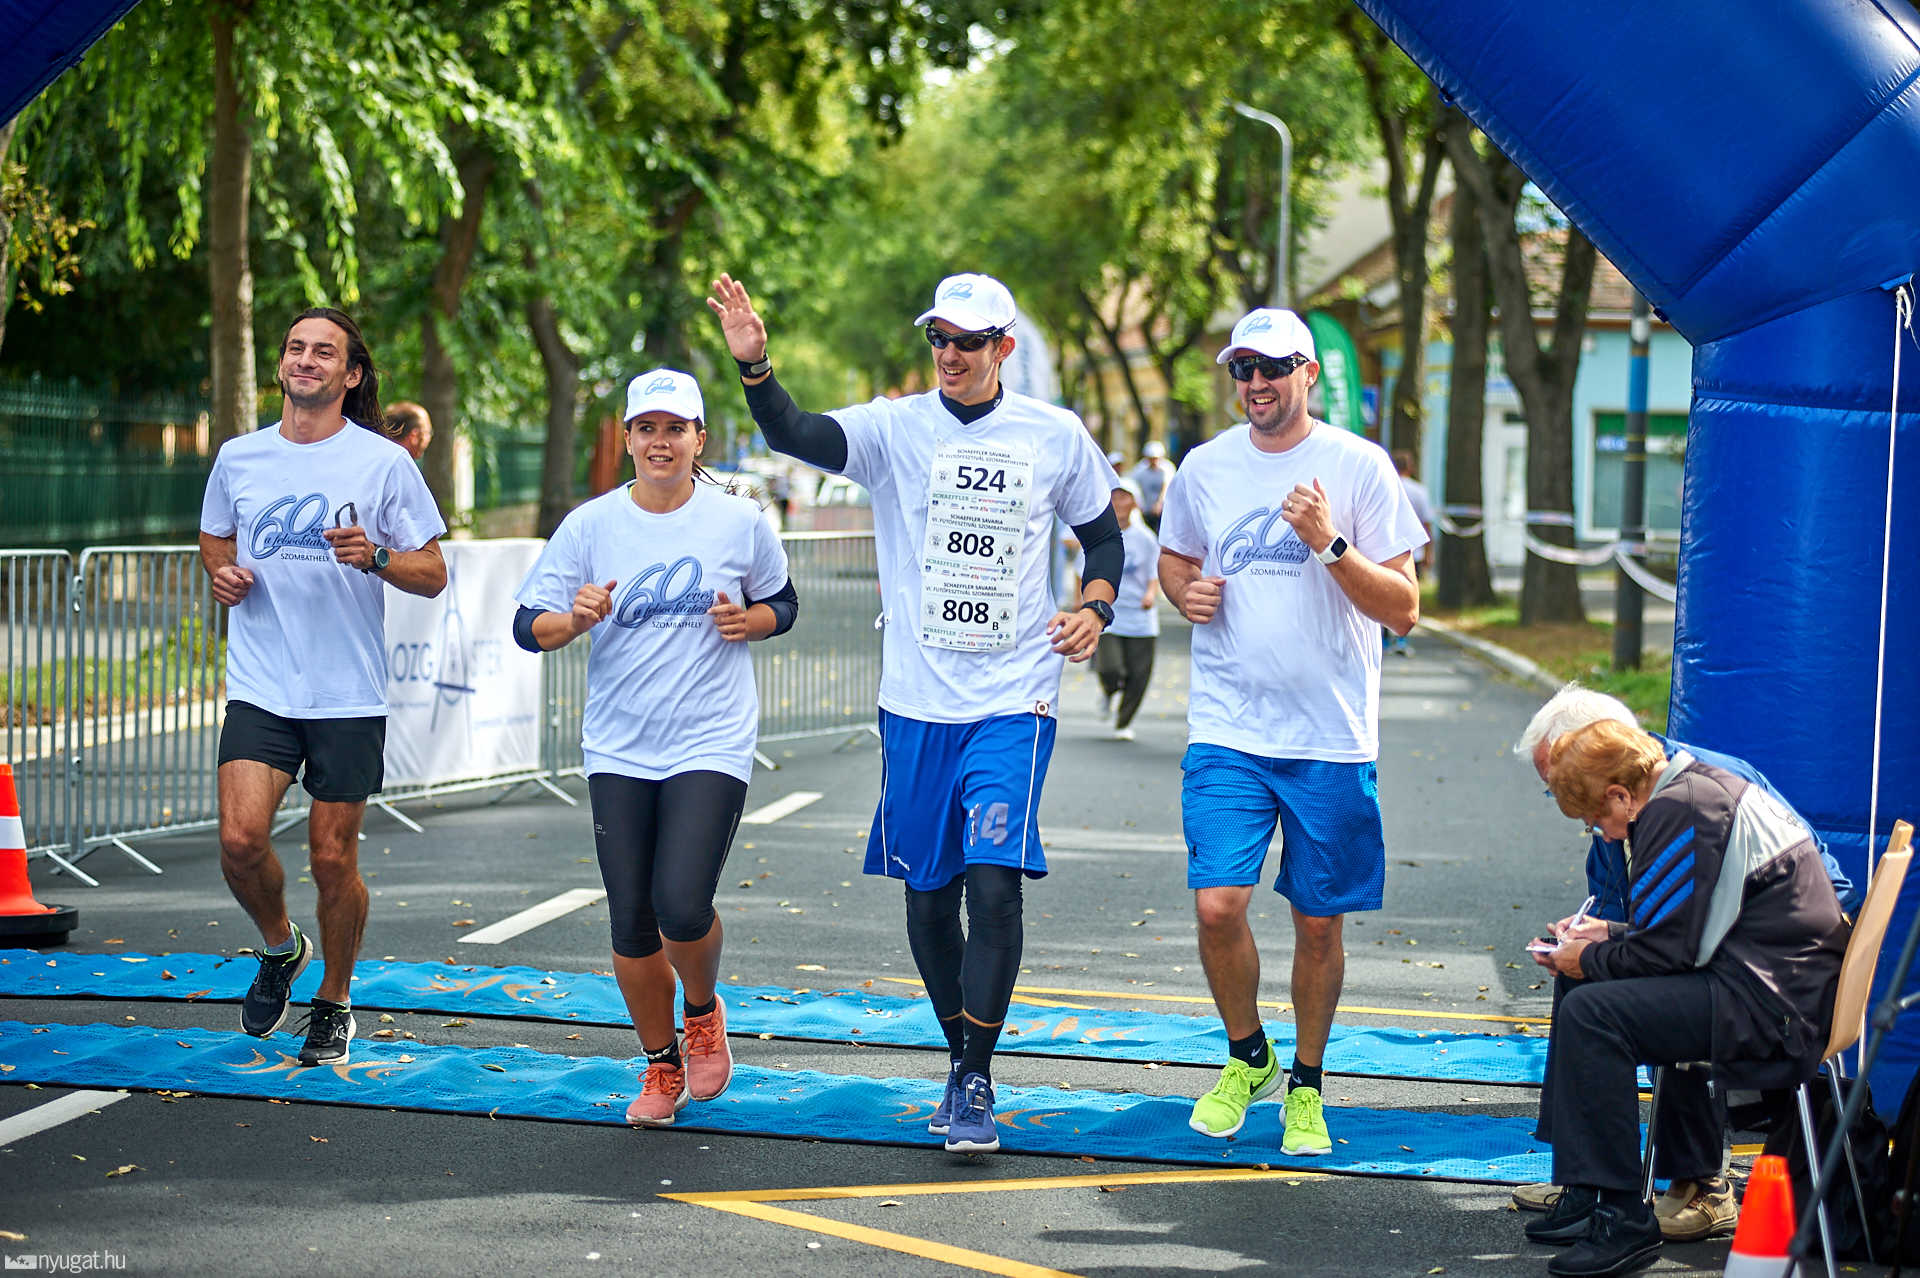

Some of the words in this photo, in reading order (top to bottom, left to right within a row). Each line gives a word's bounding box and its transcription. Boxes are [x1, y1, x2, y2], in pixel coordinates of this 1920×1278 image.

[956, 465, 1006, 493] 524
[950, 513, 981, 523] SCHAEFFLER
[982, 517, 1004, 525] SAVARIA
[248, 492, 329, 559] 60
[947, 531, 995, 557] 808
[280, 552, 329, 562] SZOMBATHELY
[996, 556, 1004, 566] A
[1250, 568, 1301, 577] SZOMBATHELY
[943, 582, 974, 590] SCHAEFFLER
[612, 556, 702, 628] 60
[942, 599, 989, 624] 808
[652, 621, 703, 629] SZOMBATHELY
[992, 621, 999, 631] B
